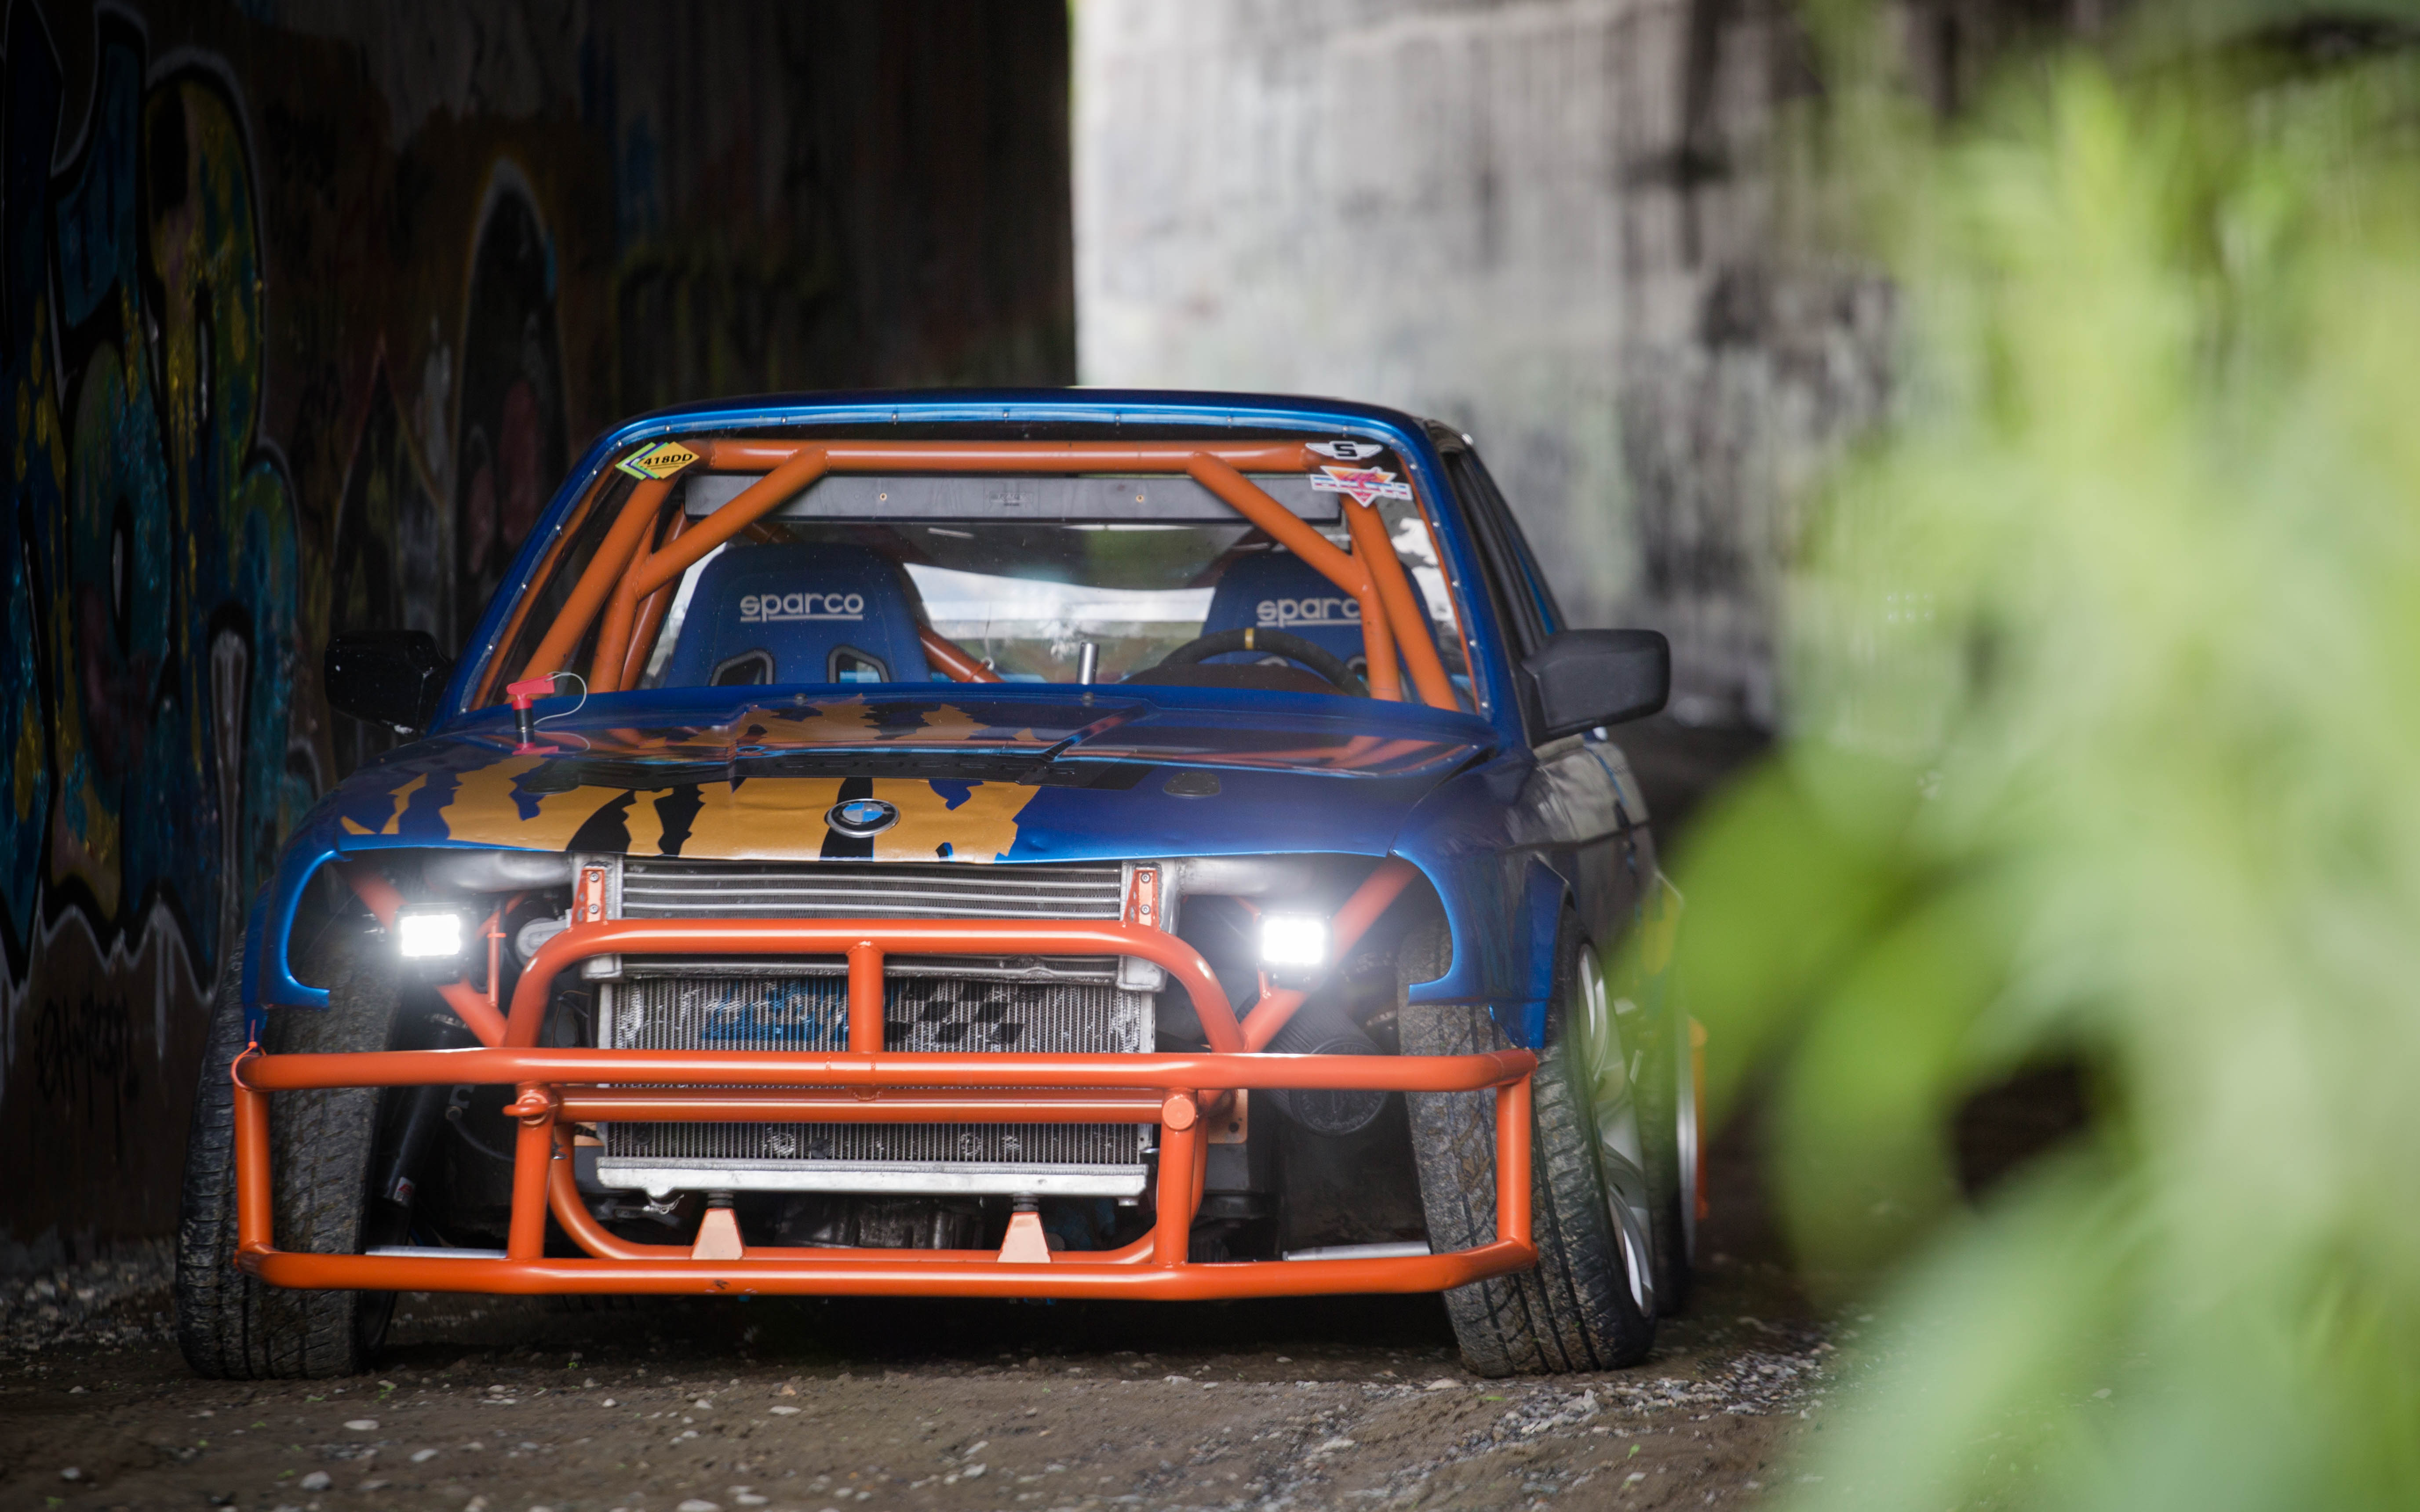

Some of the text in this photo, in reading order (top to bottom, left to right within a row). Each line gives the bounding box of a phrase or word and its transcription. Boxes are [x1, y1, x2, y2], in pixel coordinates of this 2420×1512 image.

[644, 454, 693, 465] 418DD
[740, 592, 864, 622] sparco
[1256, 597, 1360, 629] sparc
